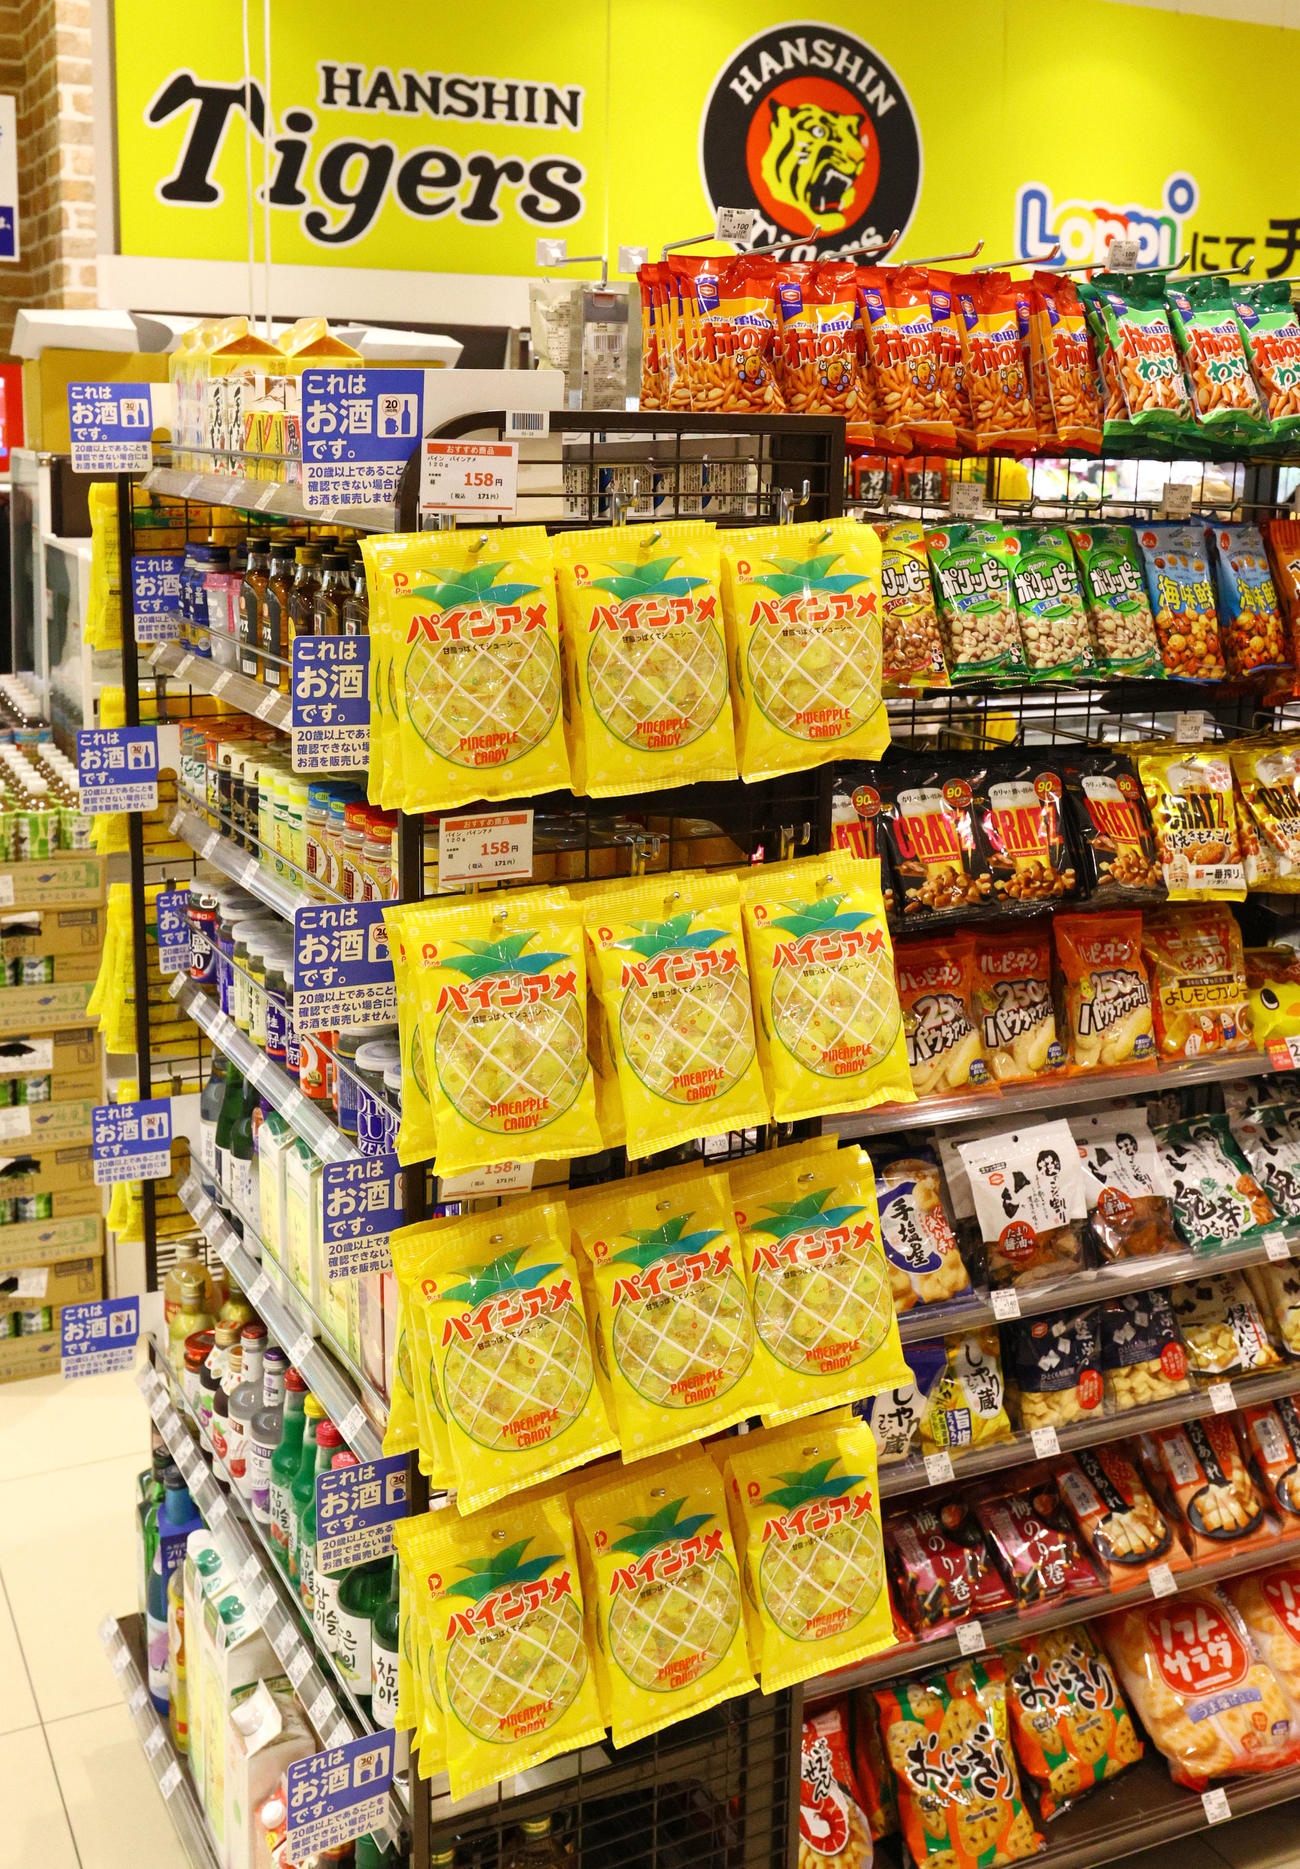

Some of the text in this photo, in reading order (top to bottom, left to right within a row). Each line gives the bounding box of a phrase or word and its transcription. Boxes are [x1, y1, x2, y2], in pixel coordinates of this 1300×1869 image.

[728, 38, 897, 119] HANSHIN
[321, 64, 582, 129] HANSHIN
[147, 72, 585, 244] Tigers
[1020, 177, 1195, 275] Loppi
[71, 386, 112, 399] これは
[306, 374, 366, 394] これは
[72, 402, 118, 425] お酒
[305, 398, 373, 434] お酒
[73, 427, 107, 440] です。
[307, 438, 356, 459] です。
[446, 445, 494, 455] おすすめ商品
[464, 472, 503, 487] 158 円
[135, 559, 174, 572] これは
[135, 574, 182, 596] お酒
[882, 560, 929, 597] リッピー
[940, 558, 1010, 600] ポリッピー
[1014, 563, 1078, 604] ポリッピー
[1089, 563, 1143, 599] ポリッピー
[137, 599, 169, 612] です。
[588, 595, 717, 638] パインアメ
[749, 592, 878, 628] パインアメ
[406, 602, 548, 645] パインアメ
[298, 641, 357, 660] これは
[296, 664, 364, 698] お酒
[297, 702, 345, 723] です。
[795, 708, 852, 726] PINEAPPLE
[637, 717, 690, 734] PINEAPPLE
[808, 723, 843, 739] CANDY
[80, 732, 119, 745] これは
[460, 730, 519, 751] PINEAPPLE
[647, 733, 682, 749] CANDY
[80, 746, 124, 769] お酒
[474, 748, 509, 766] CANDY
[82, 771, 114, 784] です。
[1037, 780, 1053, 793] 90
[1119, 781, 1132, 791] 90
[856, 795, 870, 807] 90
[946, 787, 962, 798] 90
[463, 817, 510, 829] おすすめ商品
[1084, 797, 1150, 838] CRATZ
[481, 841, 519, 856] 158 円
[300, 908, 358, 929] これは
[298, 929, 365, 964] お酒
[771, 927, 887, 969] パインアメ
[299, 966, 346, 988] です。
[620, 946, 743, 989] パインアメ
[435, 970, 578, 1014] パインアメ
[299, 1010, 397, 1029] お酒を販売しません。
[821, 1043, 873, 1064] PINEAPPLE
[672, 1066, 725, 1090] PINEAPPLE
[834, 1058, 868, 1076] CANDY
[686, 1083, 718, 1103] CANDY
[95, 1107, 134, 1121] これは
[490, 1096, 550, 1118] PINEAPPLE
[95, 1119, 139, 1143] お酒
[503, 1113, 540, 1131] CANDY
[97, 1144, 129, 1156] です。
[328, 1160, 383, 1183] これは
[484, 1160, 513, 1175] 158
[327, 1179, 390, 1216] お酒
[328, 1216, 374, 1238] です。
[891, 1197, 930, 1267] 手塩屋
[751, 1220, 877, 1275] パインアメ
[611, 1244, 734, 1308] パインアメ
[64, 1305, 103, 1320] これは
[441, 1278, 575, 1348] パインアメ
[64, 1317, 107, 1342] お酒
[65, 1342, 97, 1355] です。
[805, 1338, 861, 1363] PINEAPPLE
[819, 1353, 853, 1374] CANDY
[670, 1367, 724, 1396] PINEAPPLE
[683, 1384, 718, 1406] CANDY
[502, 1408, 560, 1436] PINEAPPLE
[517, 1426, 552, 1450] CANDY
[321, 1464, 376, 1490] これは
[320, 1480, 382, 1518] お酒
[322, 1514, 366, 1535] です。
[761, 1489, 874, 1544] パインアメ
[608, 1527, 725, 1598] パインアメ
[445, 1571, 573, 1642] パインアメ
[806, 1604, 854, 1630] PINEAPPLE
[815, 1619, 846, 1640] CANDY
[1150, 1607, 1218, 1653] ソフト
[657, 1650, 709, 1682] PINEAPPLE
[1163, 1633, 1233, 1683] サラダ
[669, 1668, 703, 1691] CANDY
[1013, 1643, 1115, 1711] おにぎり
[500, 1699, 554, 1732] PINEAPPLE
[513, 1717, 547, 1742] CANDY
[292, 1749, 345, 1779] これは
[906, 1722, 1016, 1800] おにぎり
[291, 1763, 351, 1807] お酒
[291, 1800, 335, 1824] です。
